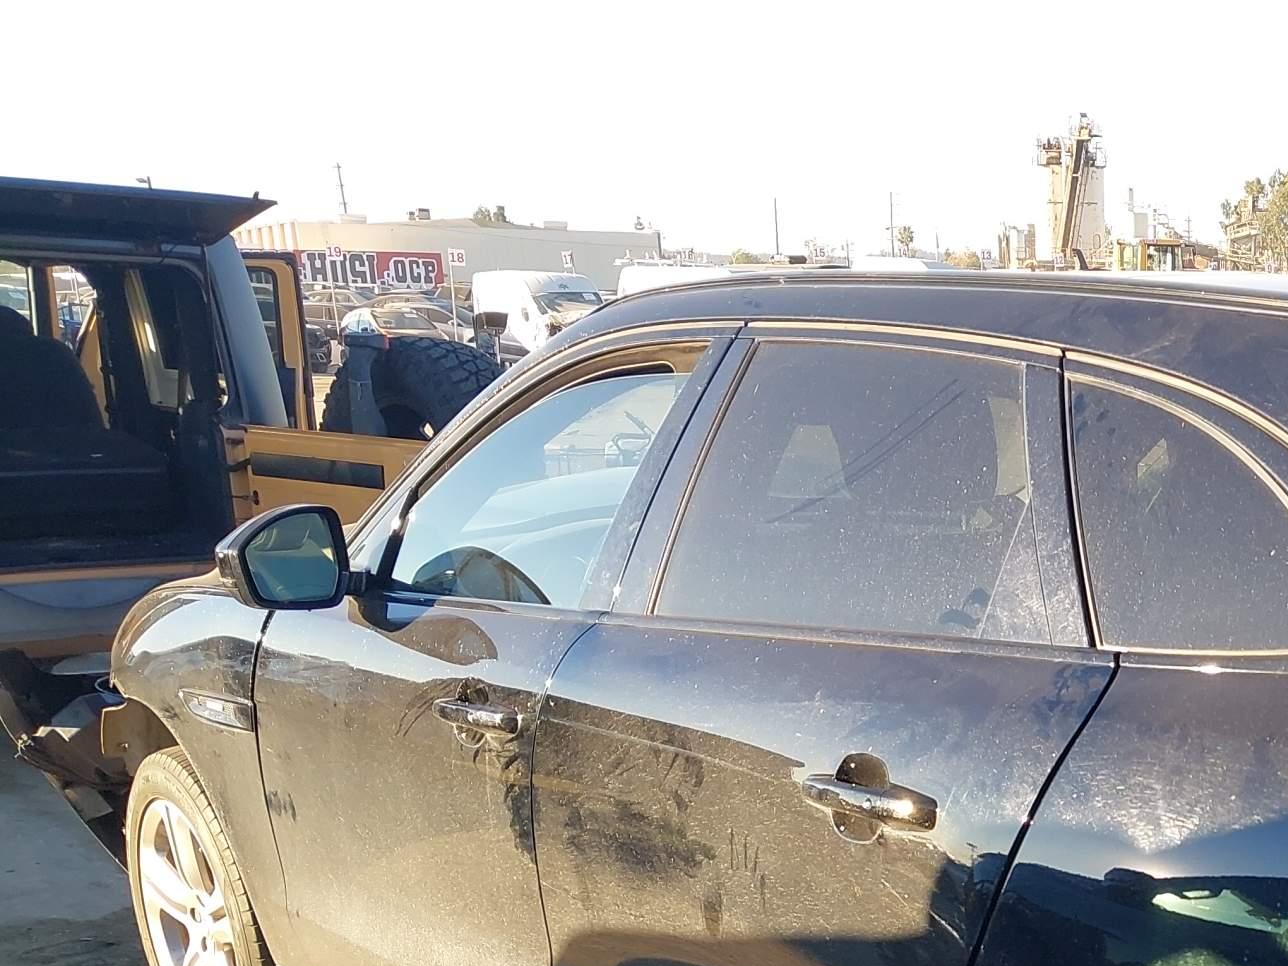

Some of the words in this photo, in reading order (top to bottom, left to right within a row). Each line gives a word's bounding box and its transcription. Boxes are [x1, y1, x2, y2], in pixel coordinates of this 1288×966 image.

[327, 246, 342, 257] 19
[814, 248, 826, 258] 15
[449, 252, 464, 263] 18
